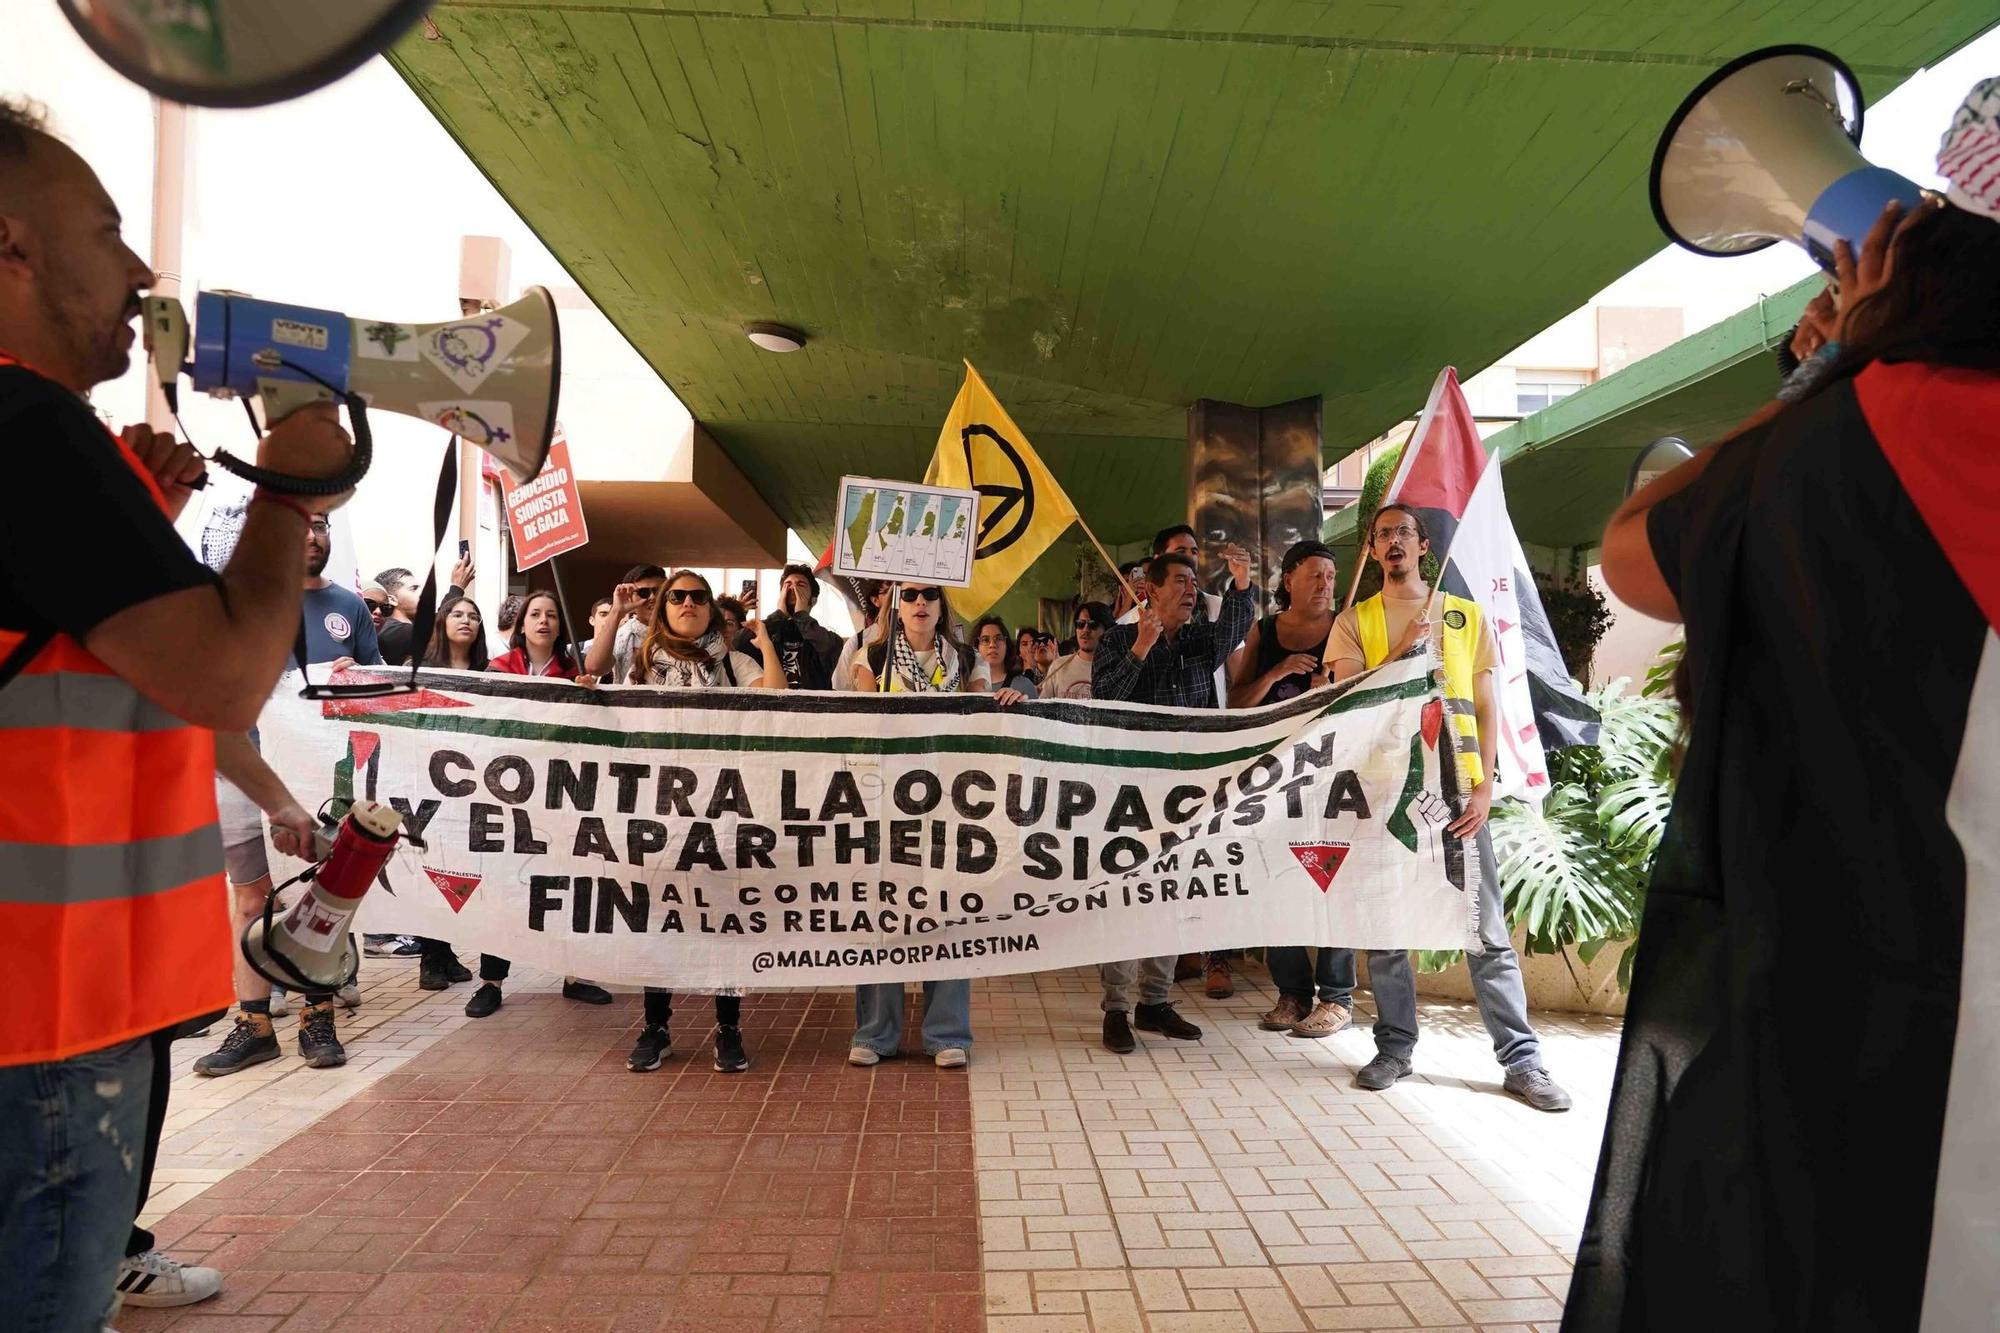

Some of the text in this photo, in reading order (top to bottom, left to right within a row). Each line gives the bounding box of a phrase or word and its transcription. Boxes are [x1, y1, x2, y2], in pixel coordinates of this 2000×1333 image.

[508, 468, 568, 508] GENOCIDIO
[515, 488, 568, 525] SIONISTA
[523, 508, 570, 542] DE GAZA
[429, 731, 1336, 832] CONTRA LA OCUPACION
[389, 797, 442, 848] Y
[469, 803, 548, 854] EL
[572, 817, 998, 874] APARTHEID
[528, 875, 650, 934] FIN
[661, 884, 710, 908] AL
[738, 881, 983, 914] COMERCIO
[661, 909, 684, 933] A
[700, 911, 768, 935] LAS
[1028, 890, 1108, 917] CON
[1123, 873, 1249, 907] ISRAEL
[752, 933, 1040, 973] @MALAGAPORPALESTINA
